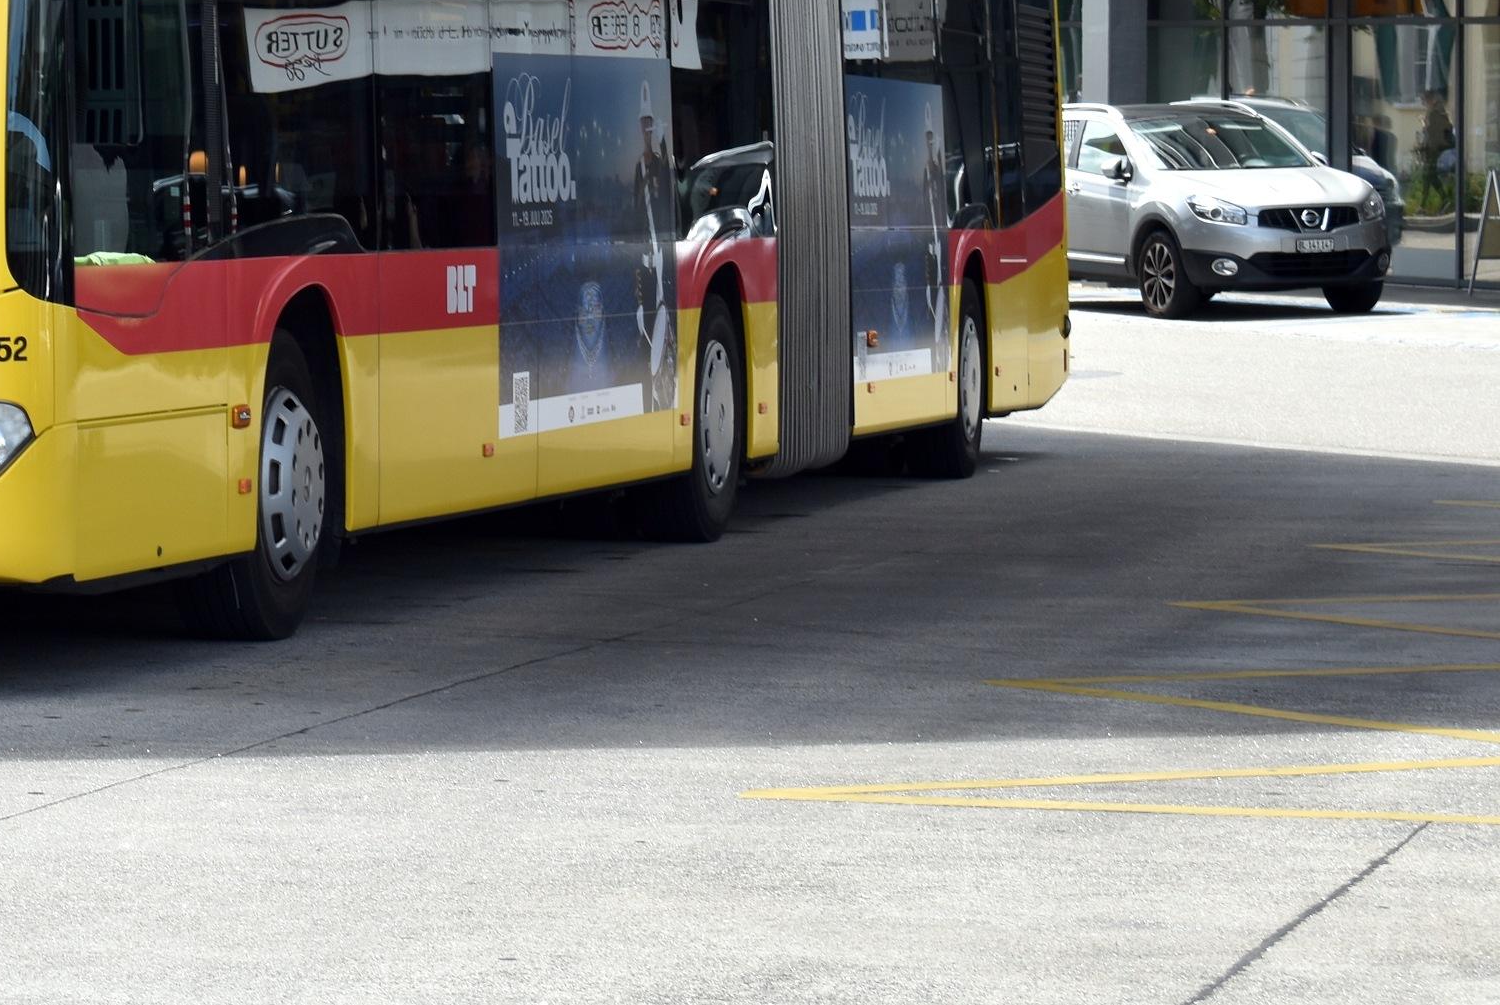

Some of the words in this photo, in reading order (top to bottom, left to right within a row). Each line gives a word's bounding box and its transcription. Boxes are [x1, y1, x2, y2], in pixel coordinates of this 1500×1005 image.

[506, 72, 572, 155] Basel
[506, 138, 576, 203] Tattoo.
[447, 265, 476, 314] BLT
